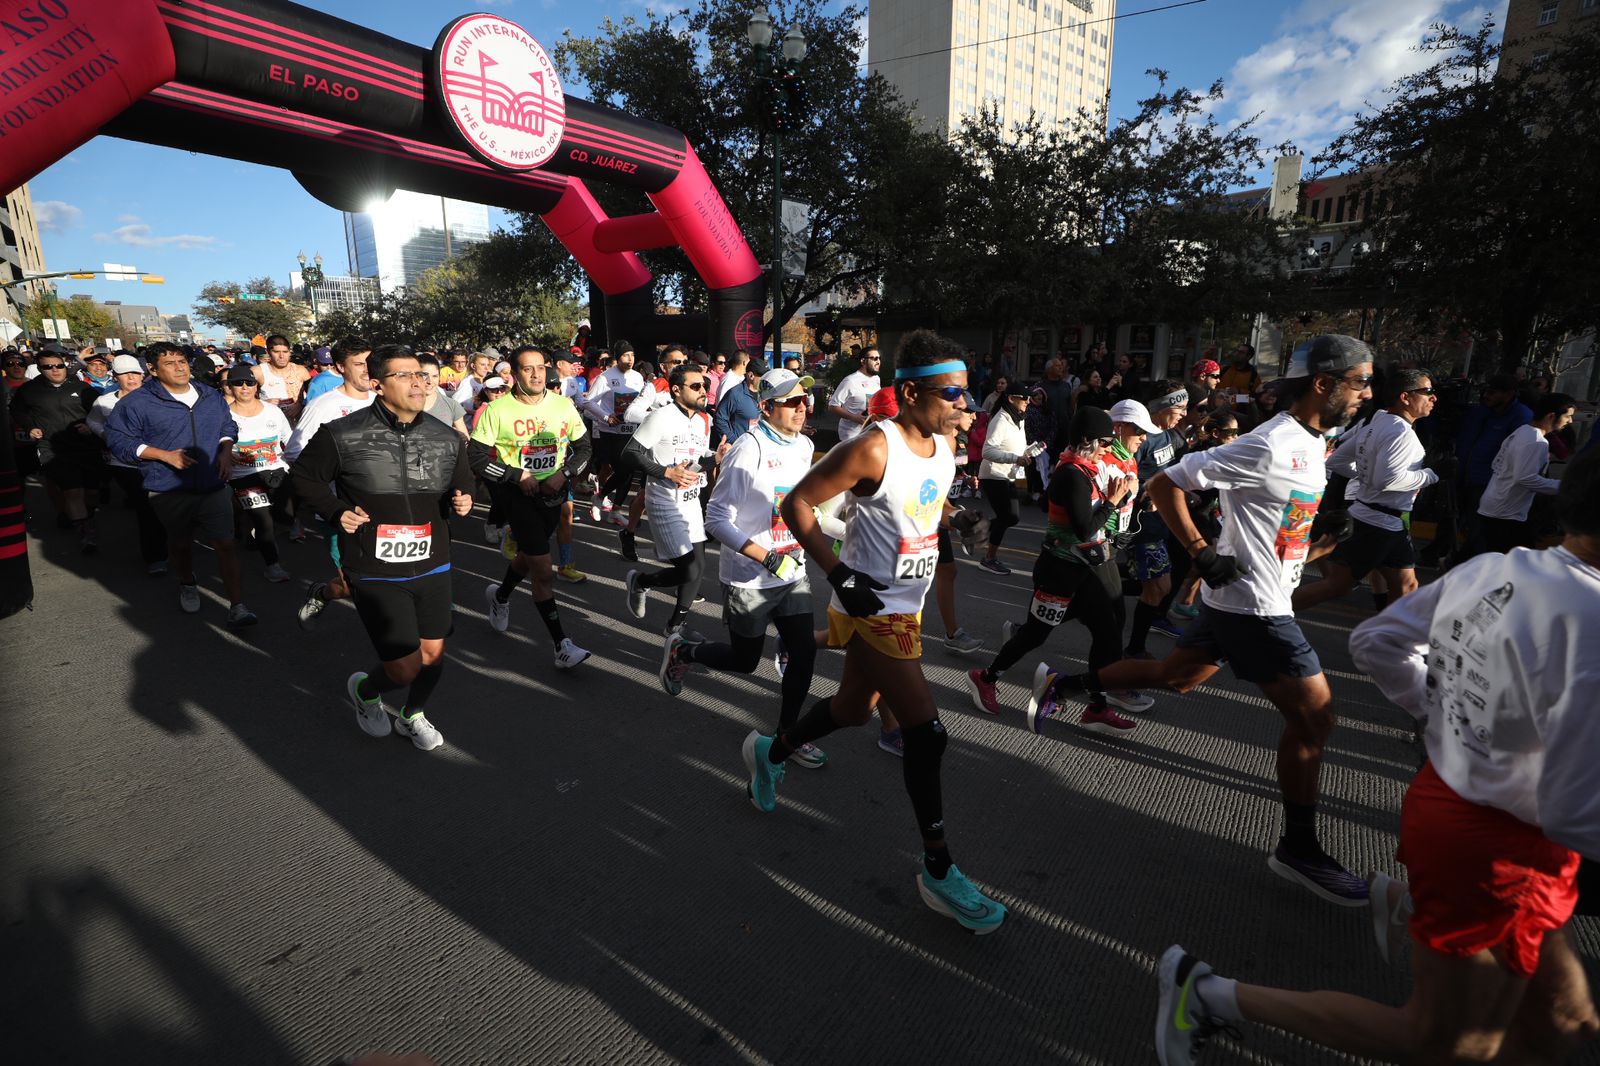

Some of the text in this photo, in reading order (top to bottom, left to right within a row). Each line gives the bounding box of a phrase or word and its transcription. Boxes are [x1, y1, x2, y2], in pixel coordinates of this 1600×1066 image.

[453, 24, 560, 97] RUN INTERNACIONAL
[269, 64, 360, 102] EL PASO
[460, 105, 479, 131] THE
[478, 131, 498, 152] U.S.
[546, 129, 559, 148] 10K
[569, 149, 639, 174] CD. JUÁREZ
[694, 200, 734, 260] FOUNDATION
[524, 456, 556, 469] 2028
[241, 494, 268, 508] 1899
[683, 488, 698, 502] 958
[380, 540, 428, 557] 2029
[1037, 605, 1064, 622] 889
